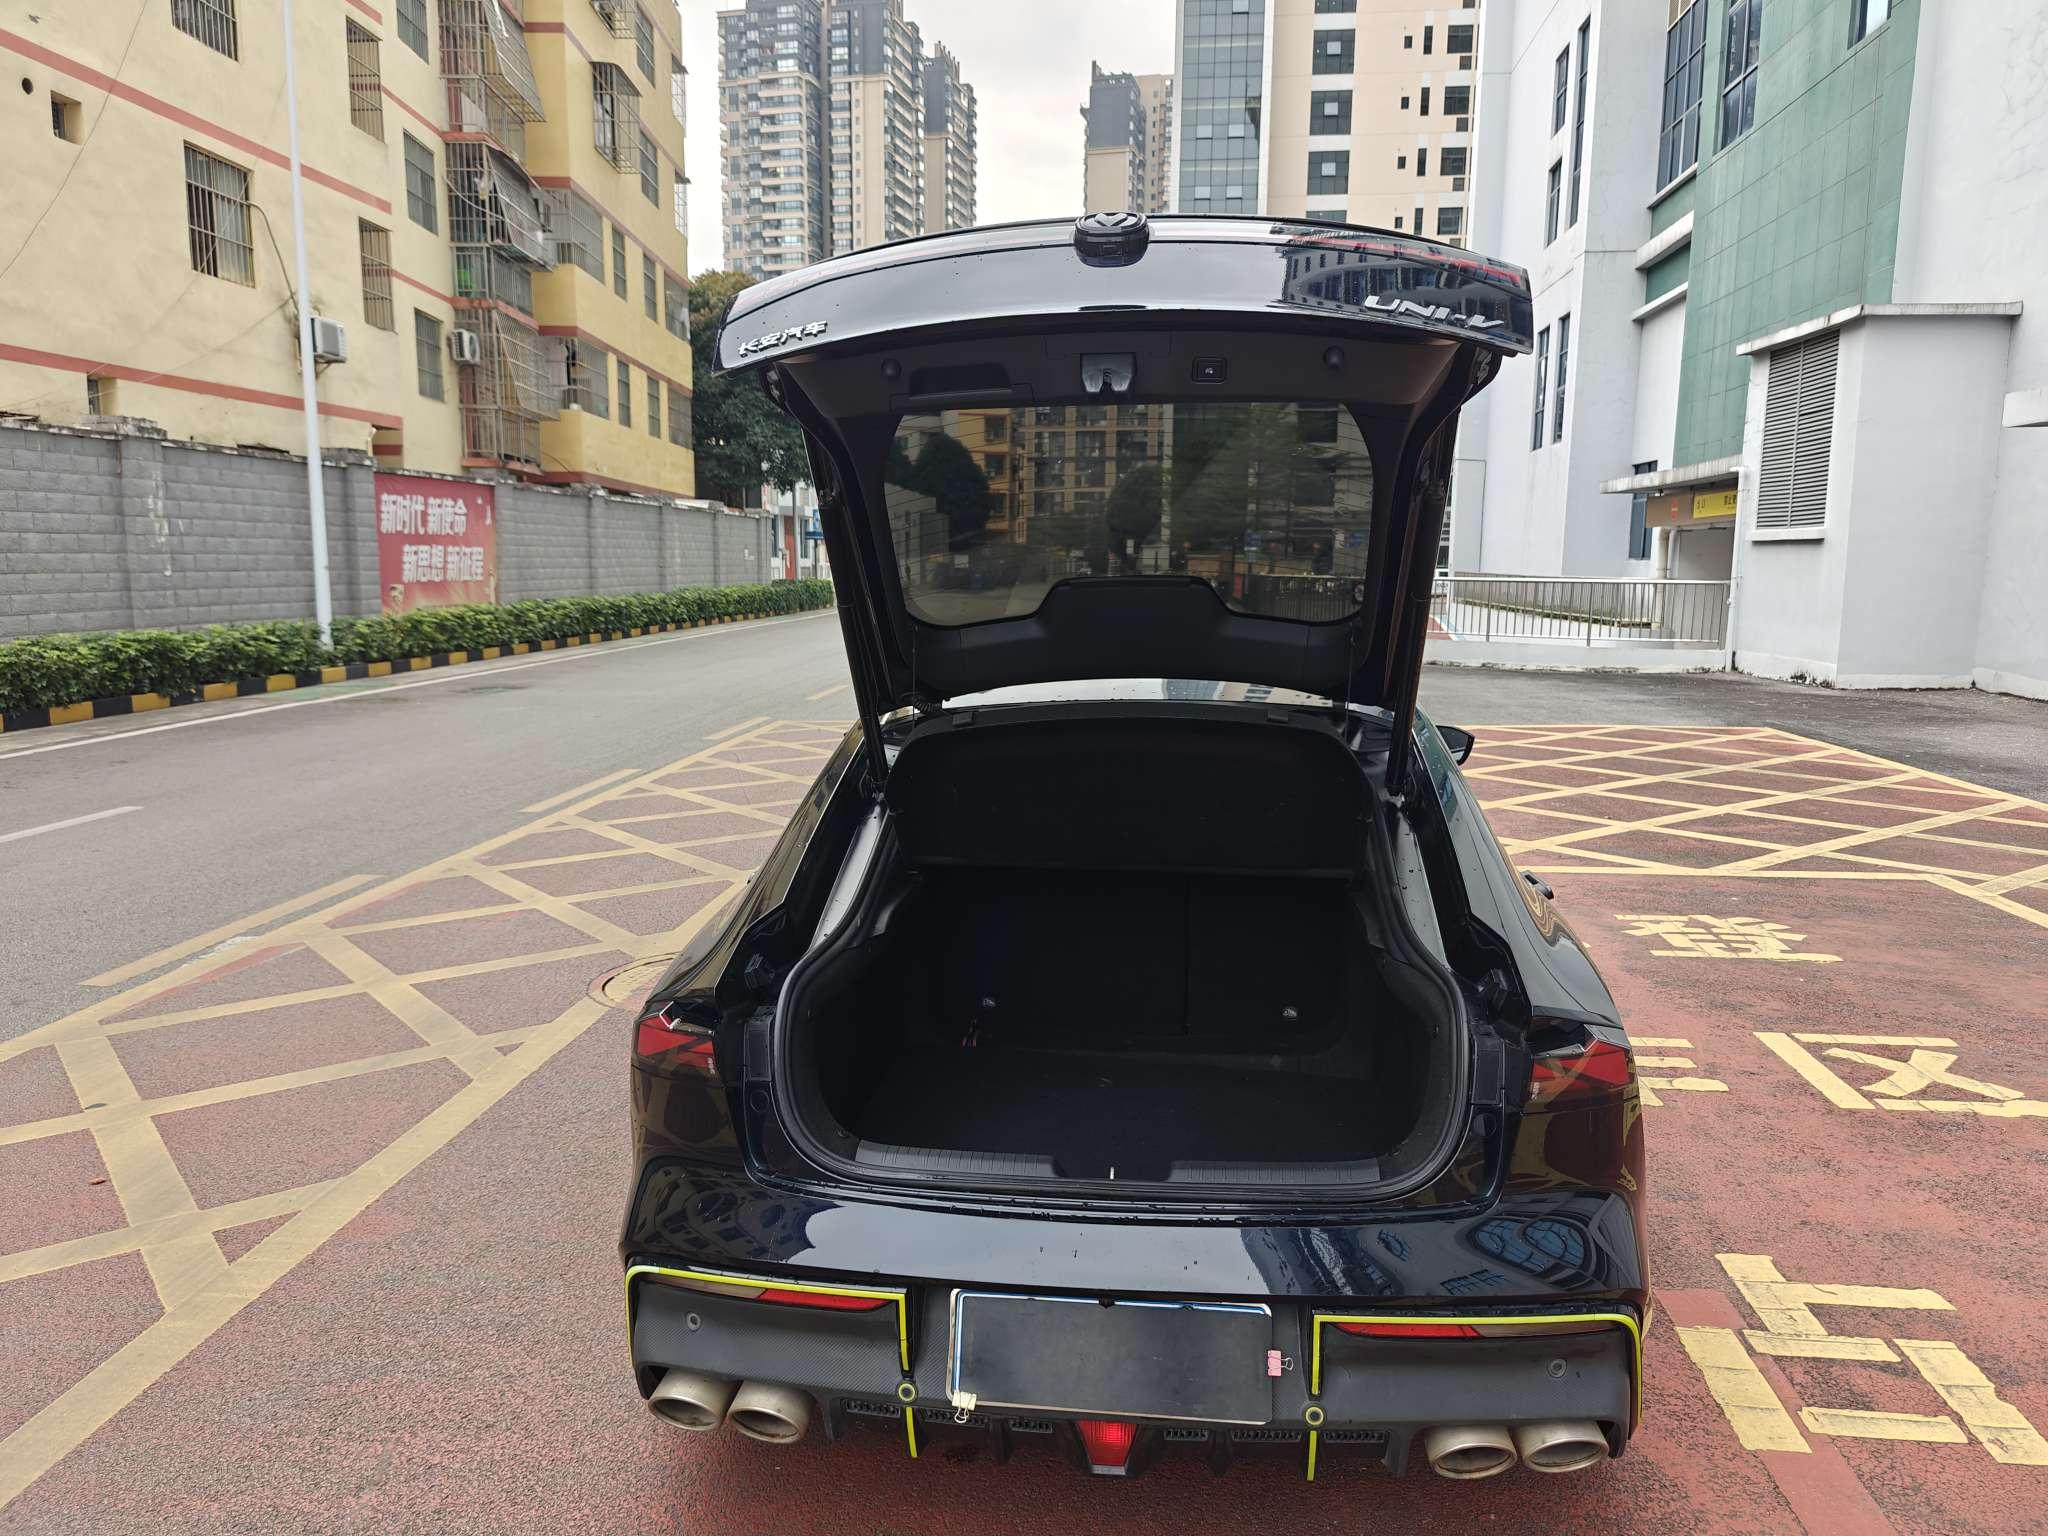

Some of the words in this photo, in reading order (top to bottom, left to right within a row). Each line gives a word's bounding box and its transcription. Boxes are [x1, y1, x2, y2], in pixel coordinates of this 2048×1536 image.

[1363, 295, 1505, 329] UNI-V
[738, 319, 828, 356] 长安汽车
[380, 492, 425, 535] 新时代
[427, 496, 468, 536] 新使命
[402, 543, 445, 583] 新思想
[446, 545, 484, 582] 新征程
